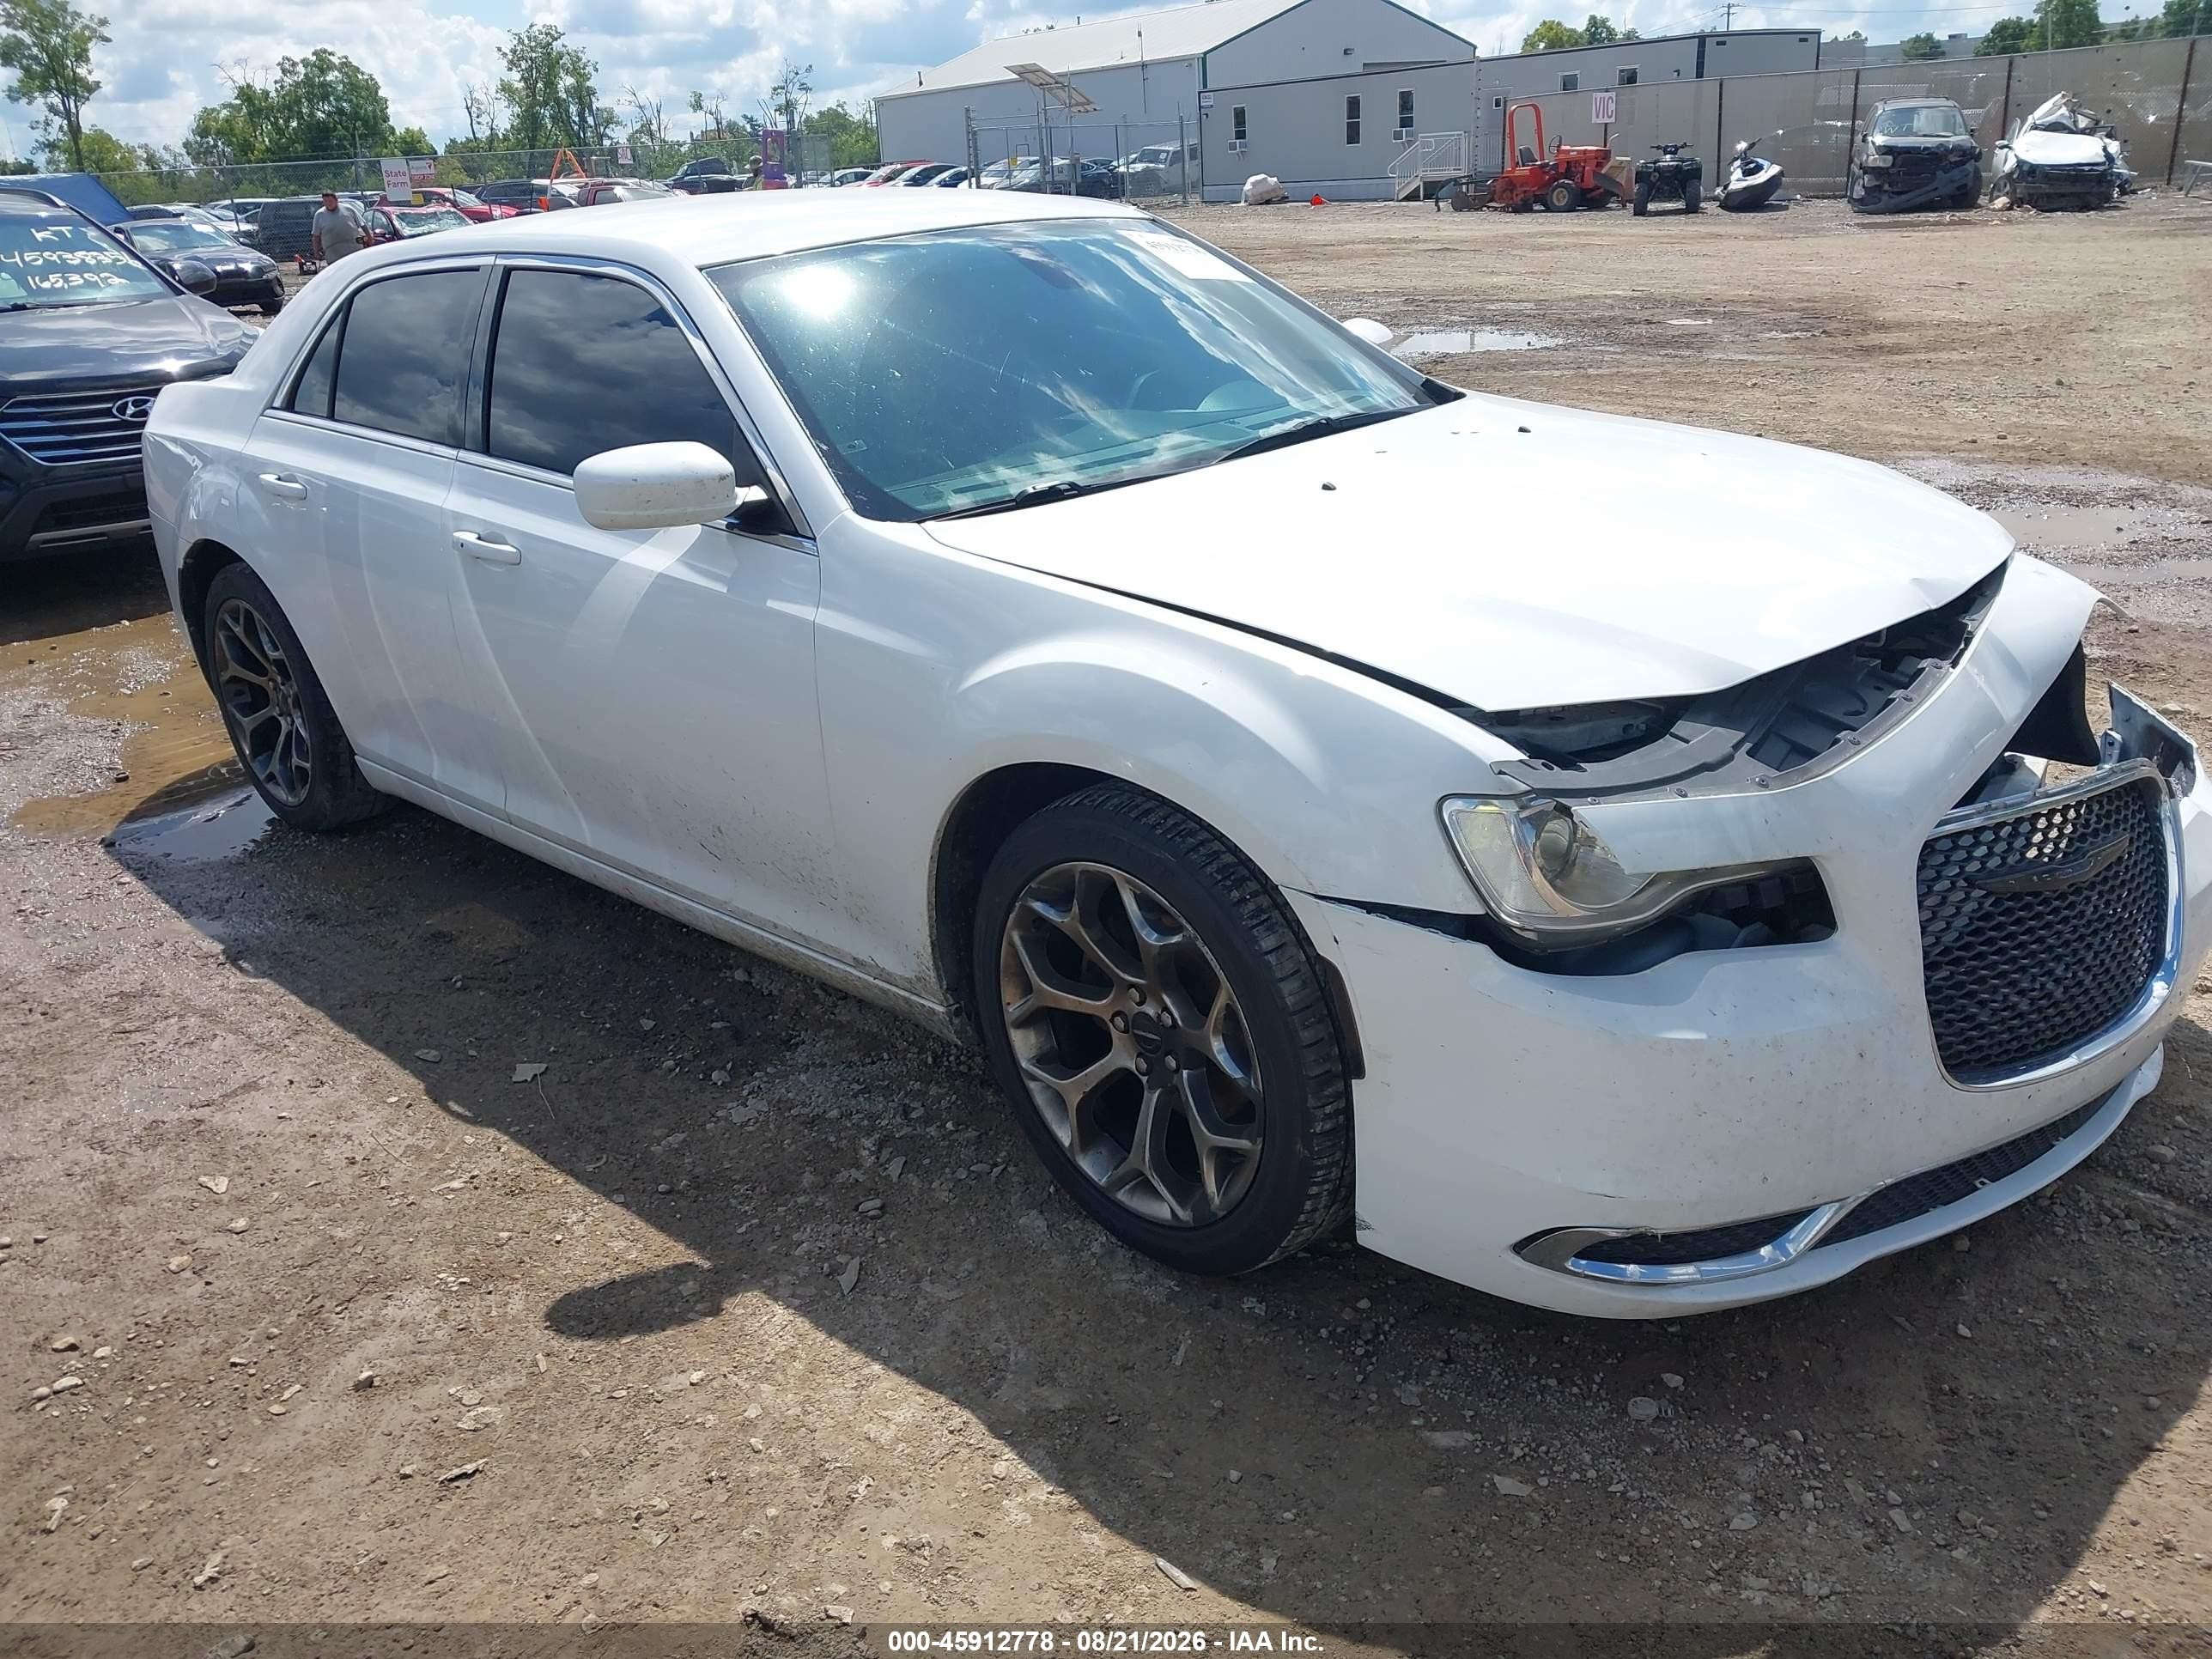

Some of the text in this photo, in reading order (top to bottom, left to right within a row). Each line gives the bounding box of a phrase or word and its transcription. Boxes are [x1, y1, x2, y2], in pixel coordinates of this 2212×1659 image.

[1594, 95, 1614, 119] VIC
[384, 169, 407, 178] State
[30, 226, 73, 242] KT
[27, 272, 131, 289] 165,392
